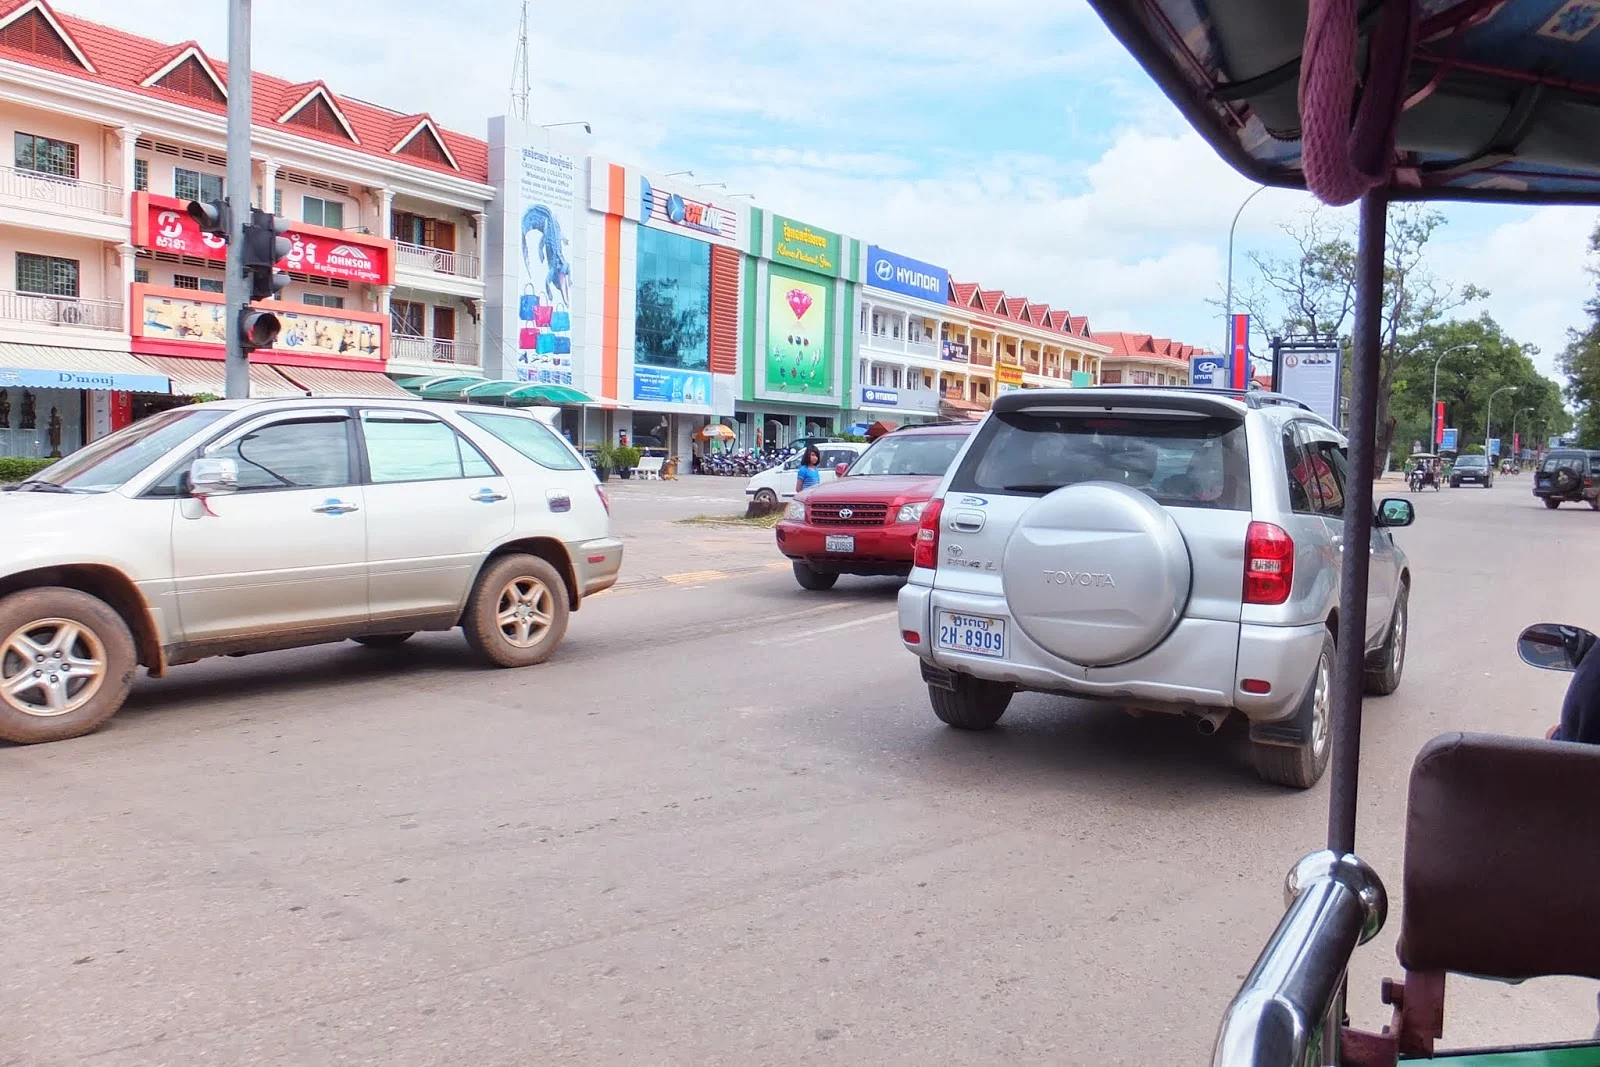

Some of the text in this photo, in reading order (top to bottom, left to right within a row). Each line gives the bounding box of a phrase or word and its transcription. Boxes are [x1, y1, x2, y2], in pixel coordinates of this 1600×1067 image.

[547, 169, 573, 181] COLLECTION
[327, 255, 371, 270] JOHNSON
[896, 267, 940, 293] HYUNDAI
[59, 373, 114, 386] D'mouj
[875, 391, 898, 401] HYUNDAI
[1043, 569, 1116, 588] TOYOTA
[941, 626, 1002, 650] 2H-8909
